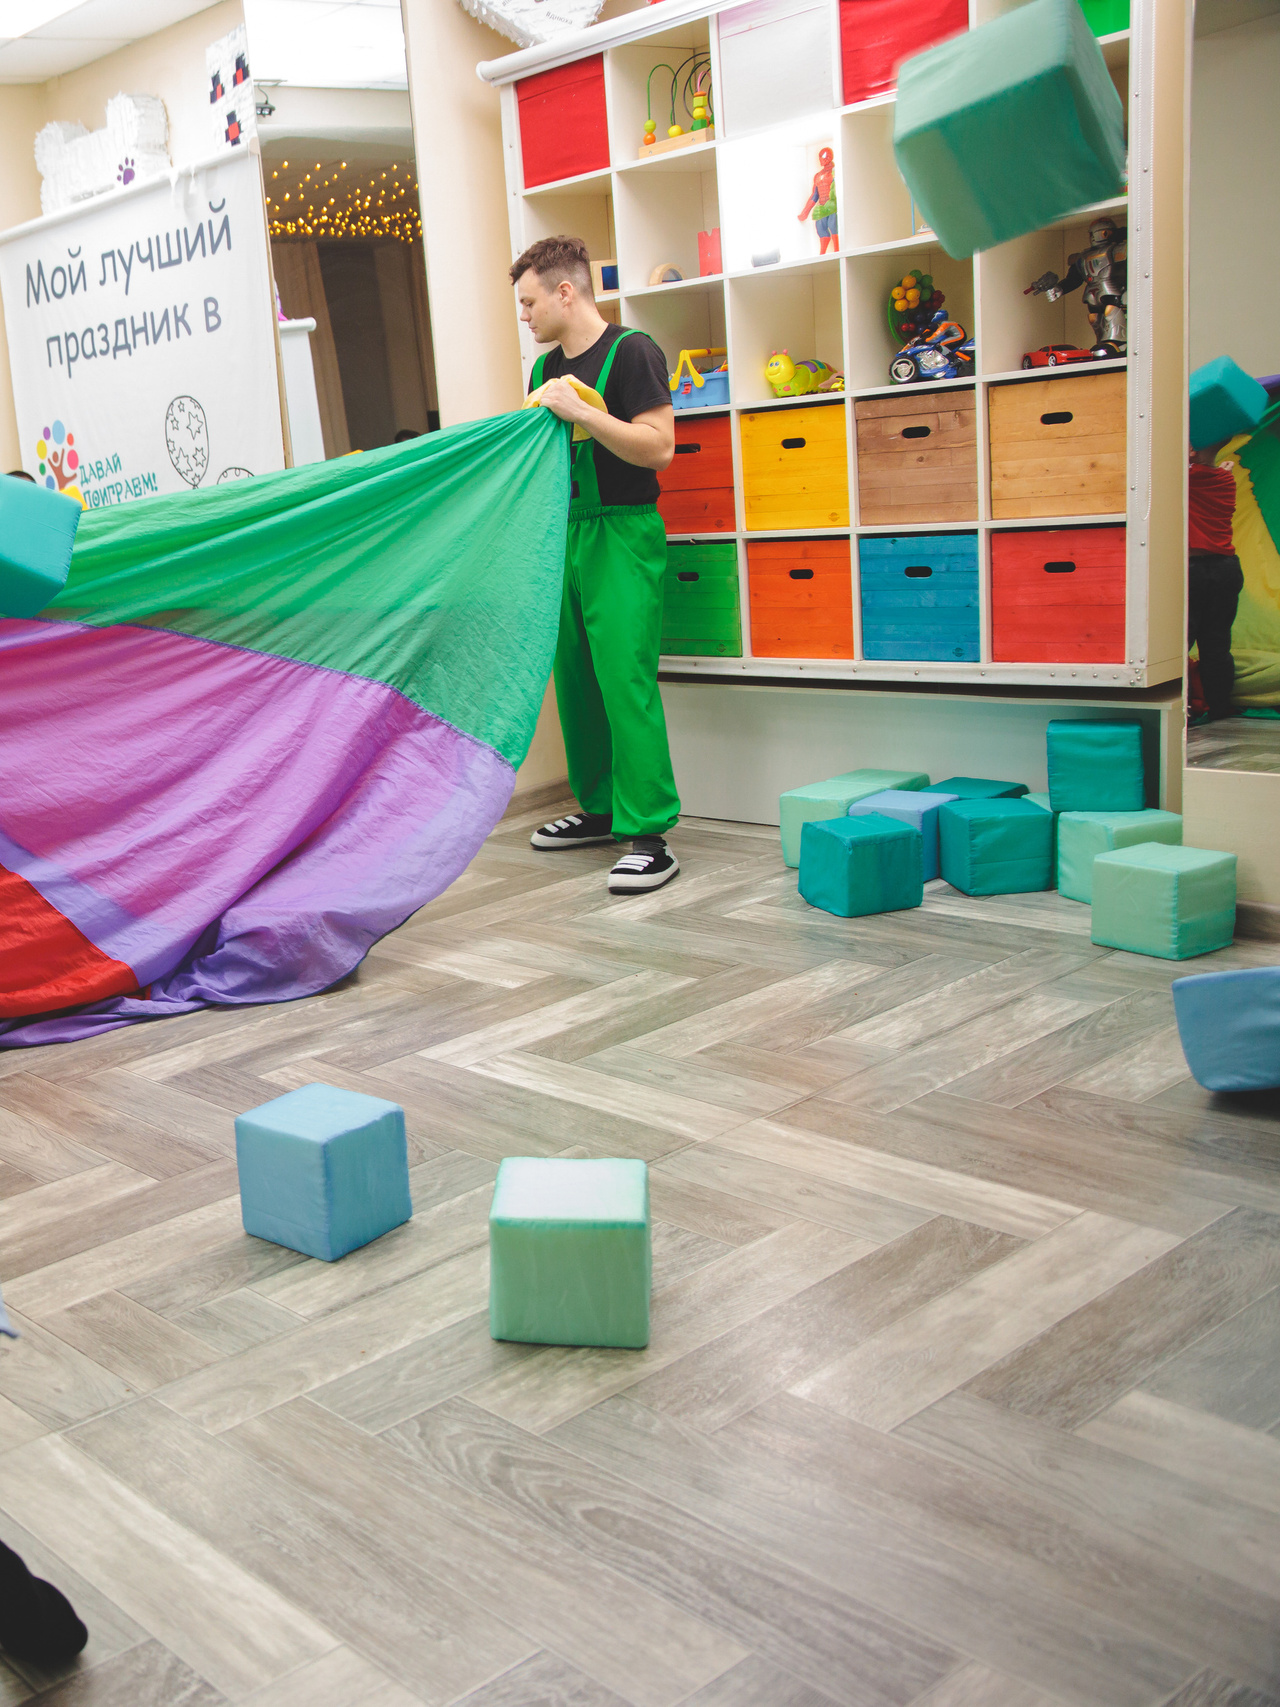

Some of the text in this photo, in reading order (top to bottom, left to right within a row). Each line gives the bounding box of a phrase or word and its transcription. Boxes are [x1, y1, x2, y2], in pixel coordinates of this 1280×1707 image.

[25, 198, 232, 308] Мой лучший
[45, 303, 192, 379] праздник
[79, 452, 122, 487] ДАВАЙ
[83, 472, 158, 508] ПОИГРАЕМ!
